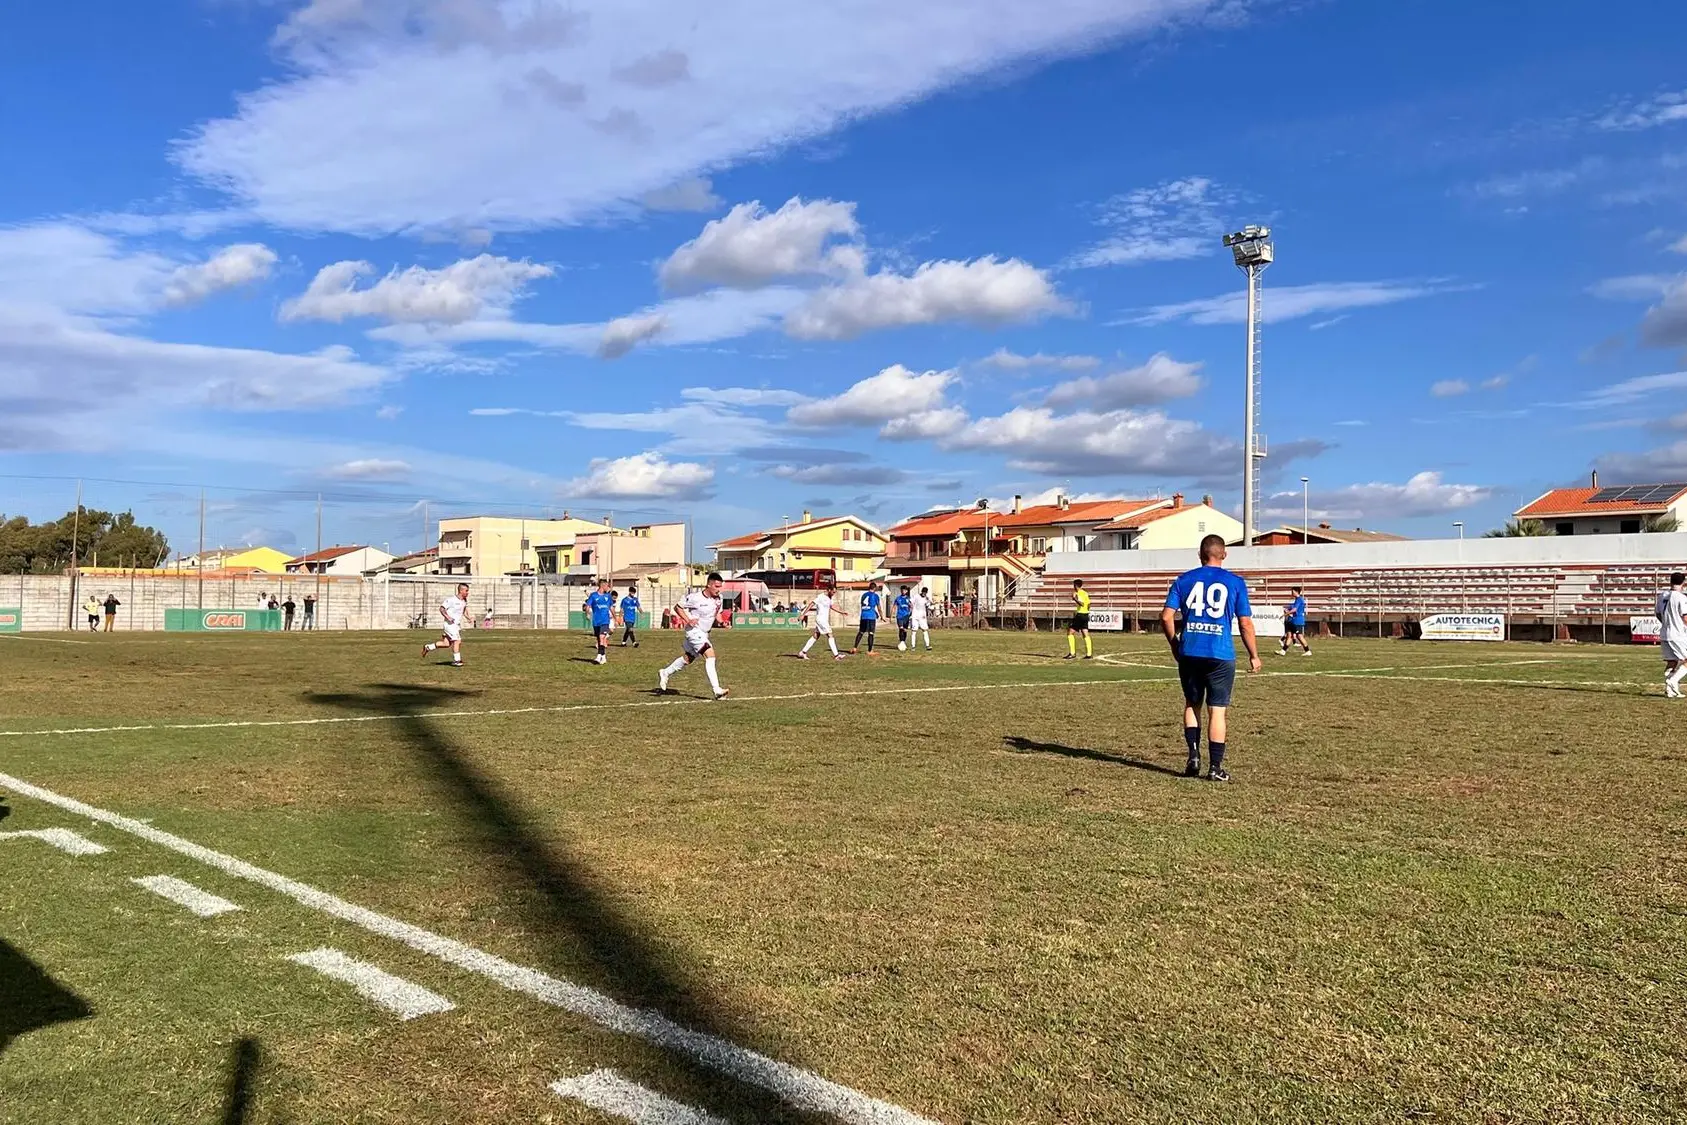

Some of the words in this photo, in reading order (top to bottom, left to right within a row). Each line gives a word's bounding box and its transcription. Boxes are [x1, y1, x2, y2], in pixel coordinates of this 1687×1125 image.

[863, 595, 870, 607] 4
[1186, 581, 1228, 619] 49
[206, 614, 244, 627] CRAI
[1435, 616, 1501, 625] AUTOTECNICA
[1187, 622, 1224, 633] ISOTEX
